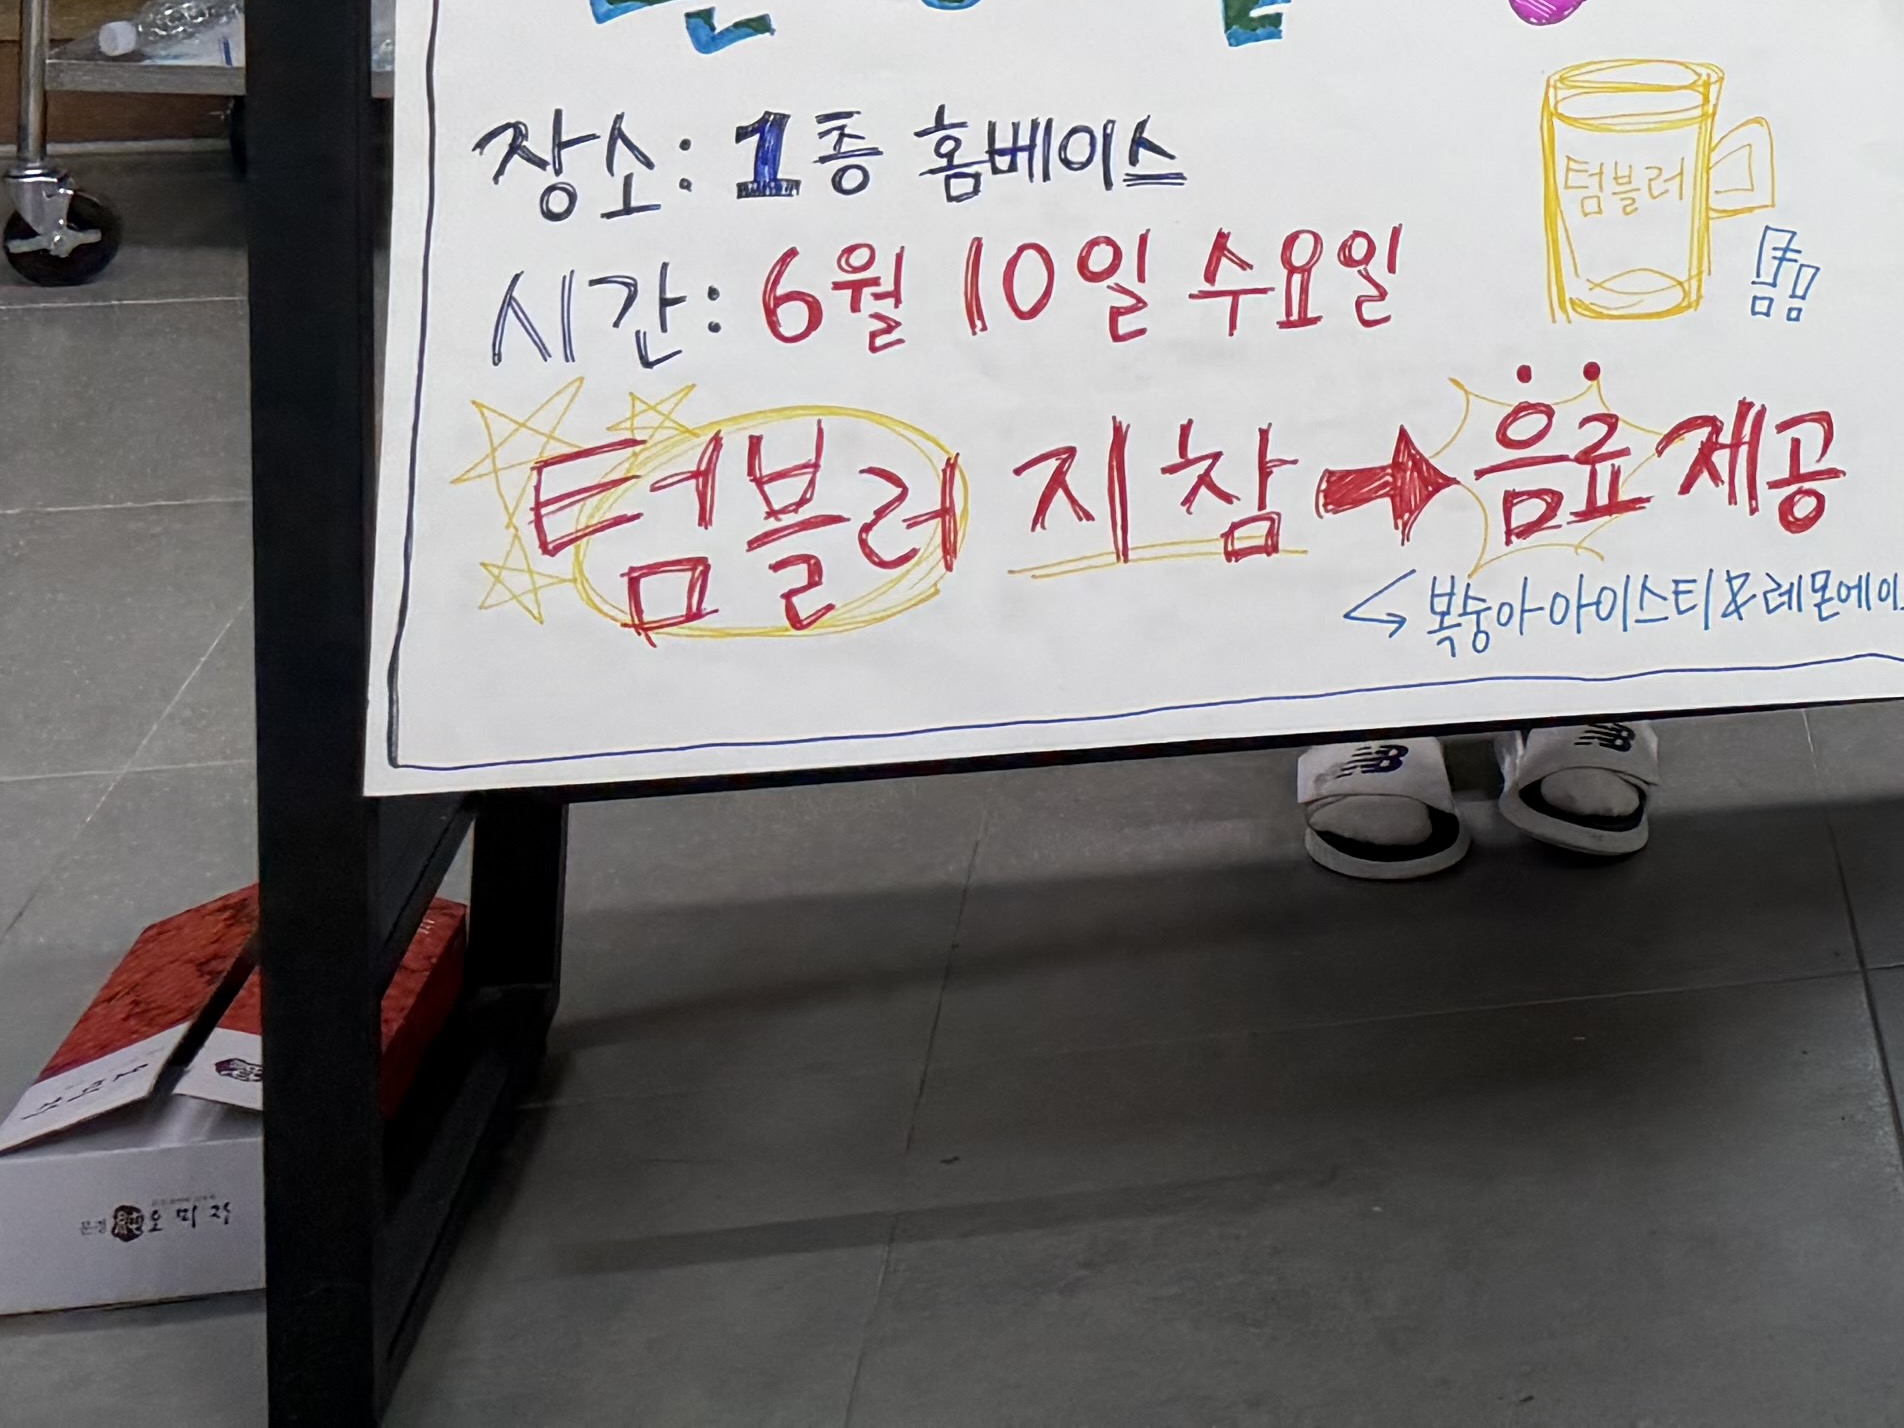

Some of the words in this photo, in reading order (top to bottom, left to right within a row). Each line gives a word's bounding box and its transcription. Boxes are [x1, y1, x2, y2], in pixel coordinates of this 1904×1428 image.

[472, 108, 693, 222] 장소:
[734, 110, 885, 199] 1층
[914, 103, 1187, 204] 홈베이스
[1563, 155, 1686, 218] 텀블러
[491, 261, 721, 369] 시간:
[761, 241, 906, 354] 6월
[966, 228, 1152, 343] 10일
[1187, 223, 1403, 338] 수요일
[530, 417, 960, 647] 텀블러
[1010, 415, 1299, 565] 지참
